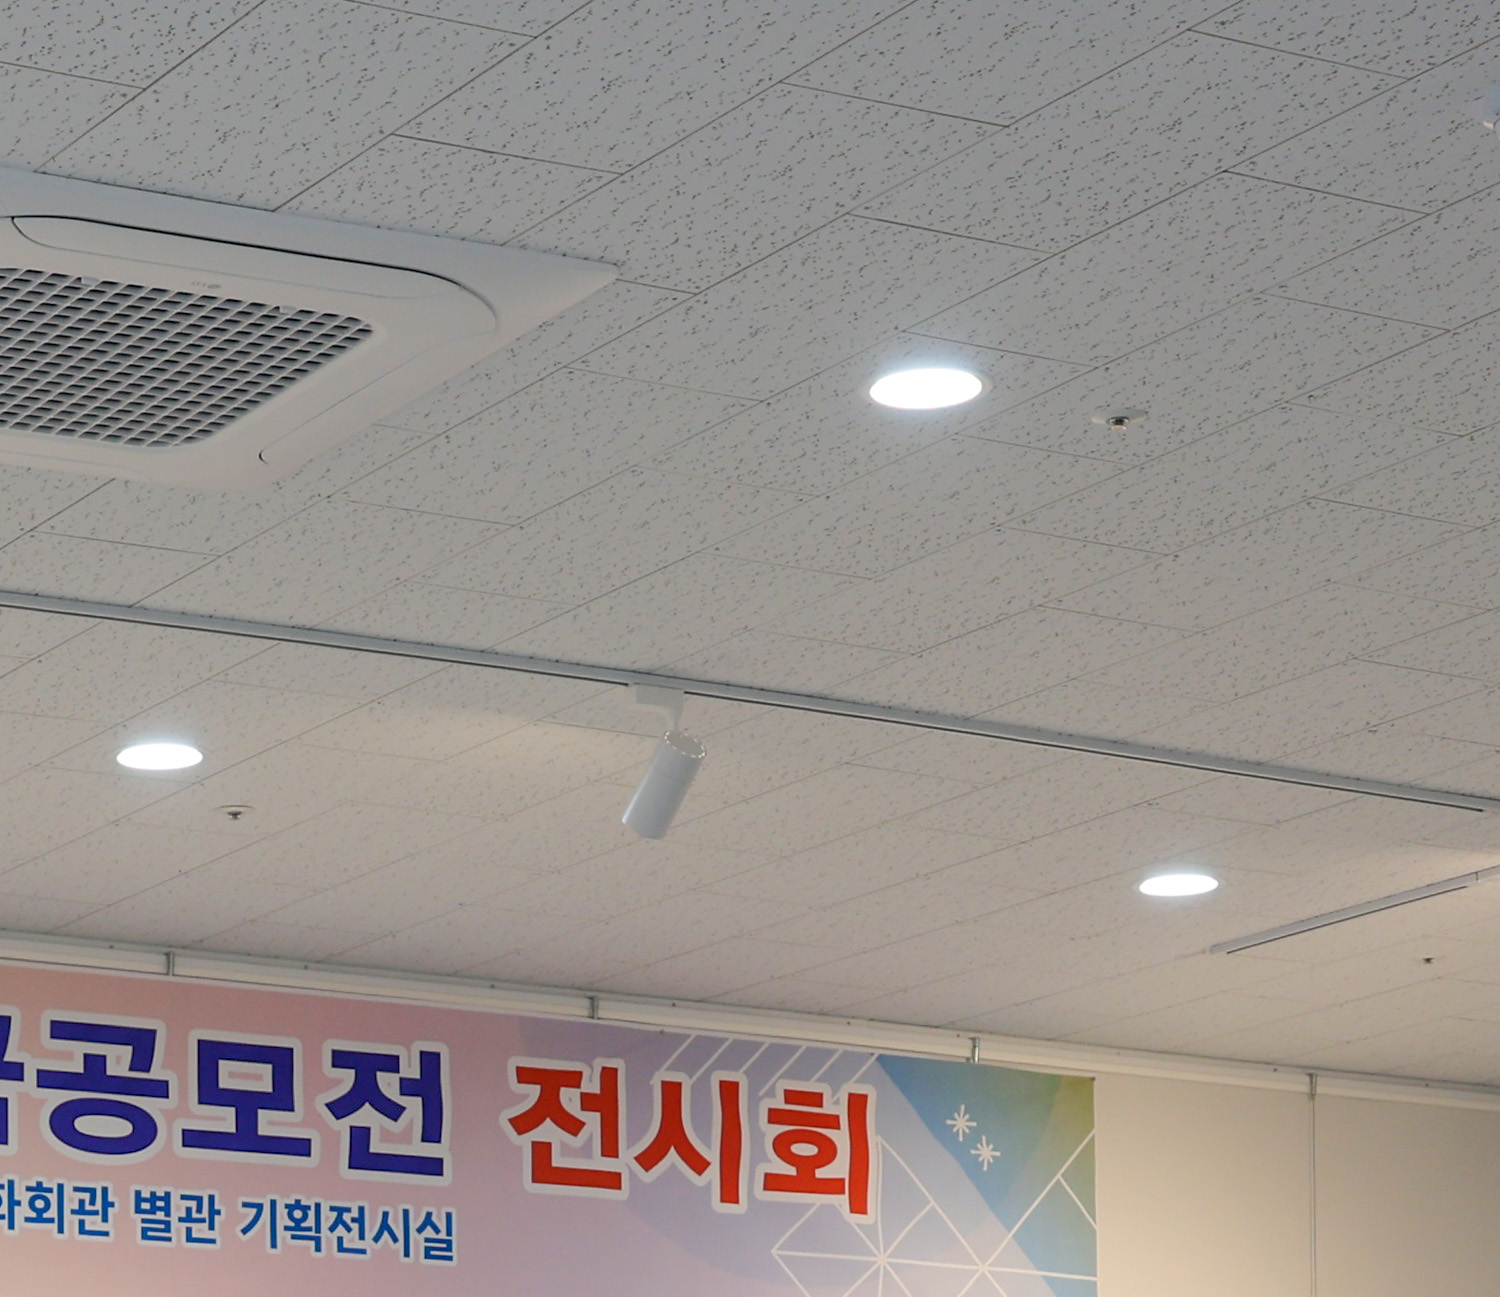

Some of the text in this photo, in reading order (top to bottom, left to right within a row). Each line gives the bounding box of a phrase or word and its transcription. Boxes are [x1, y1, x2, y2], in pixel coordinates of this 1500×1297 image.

[510, 1064, 870, 1215] 전시회
[134, 1188, 222, 1245] 별관
[240, 1198, 456, 1263] 기획전시실
